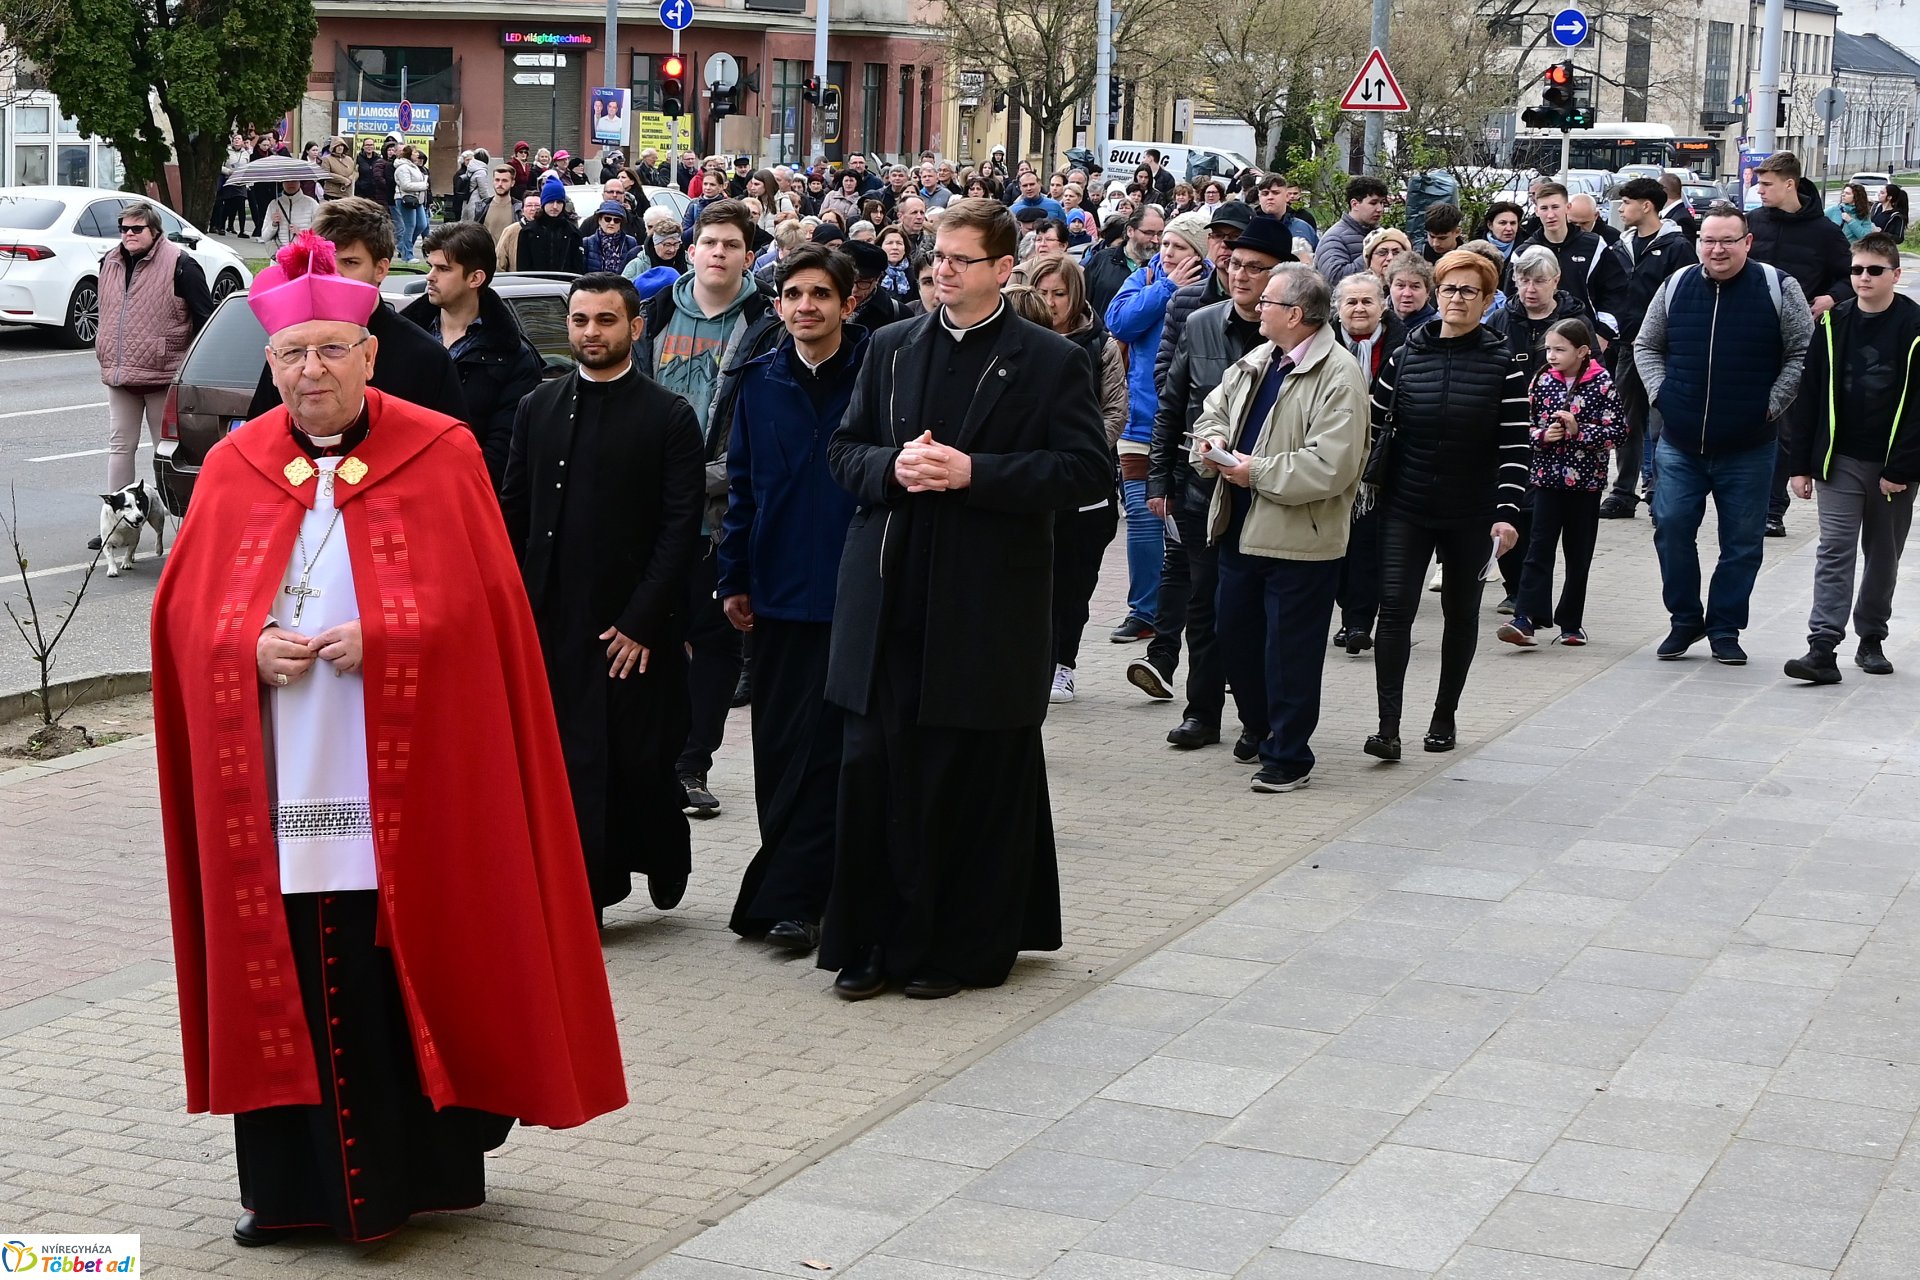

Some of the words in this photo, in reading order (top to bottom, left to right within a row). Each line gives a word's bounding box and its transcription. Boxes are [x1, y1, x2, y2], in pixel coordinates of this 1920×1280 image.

[505, 33, 521, 42] LED
[523, 33, 592, 44] világítástechnika
[394, 121, 432, 133] PZSÁK
[1109, 150, 1170, 167] BULLG
